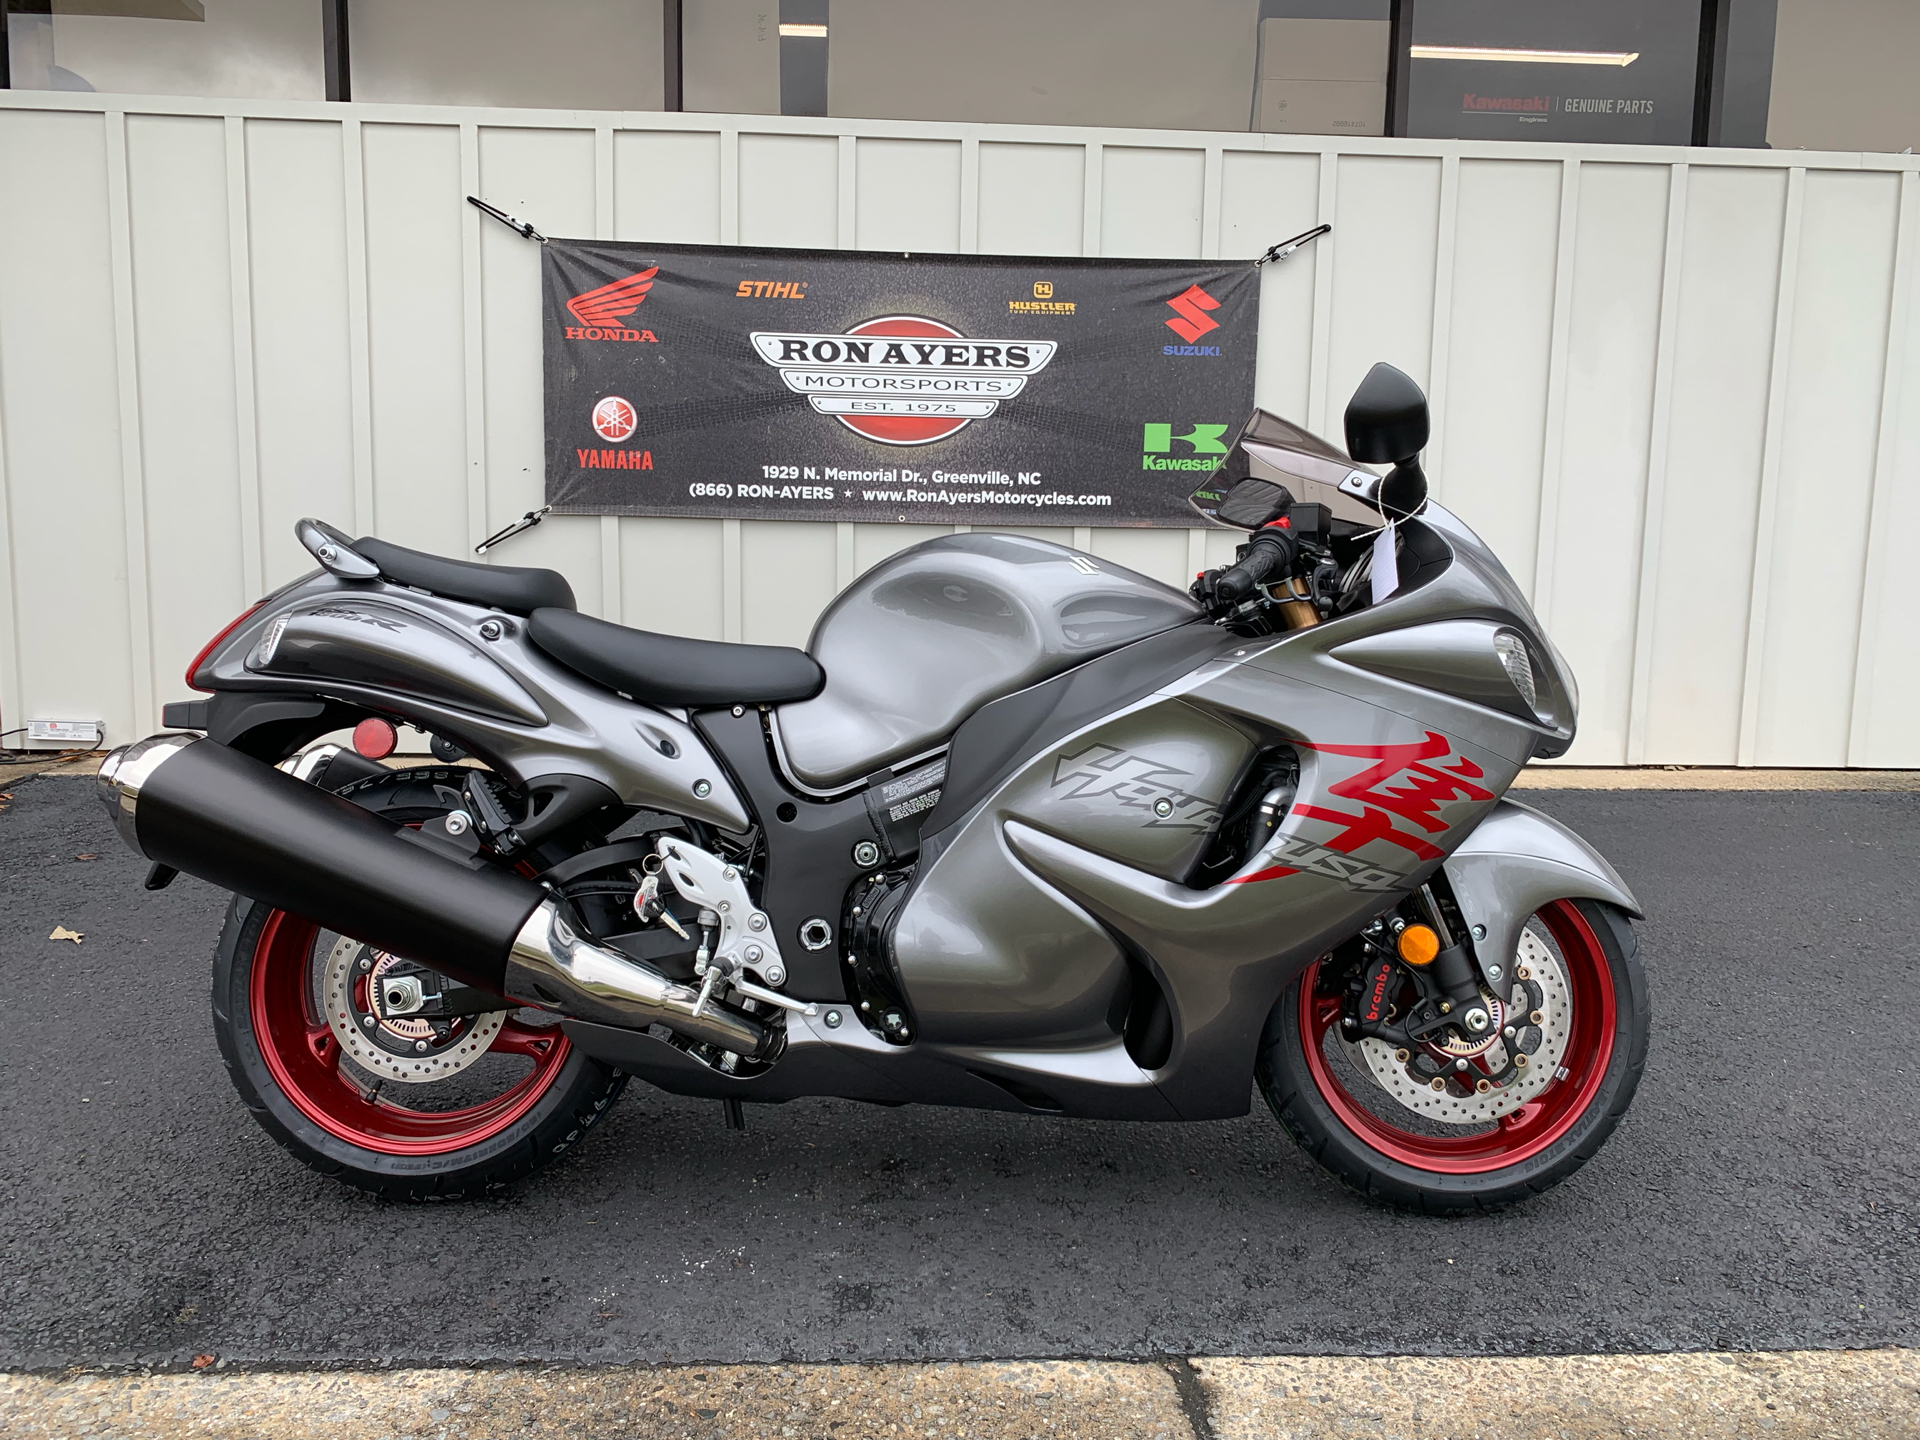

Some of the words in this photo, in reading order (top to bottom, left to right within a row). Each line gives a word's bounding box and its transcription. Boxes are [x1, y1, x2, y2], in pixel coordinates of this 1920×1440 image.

[1462, 93, 1551, 112] Kawasaki
[1564, 98, 1614, 114] GENUINE
[1616, 99, 1655, 115] PARTS
[1518, 116, 1549, 124] Engines
[1008, 301, 1076, 312] HUSTLER
[565, 326, 659, 343] HONDA
[777, 338, 875, 364] RON
[883, 341, 1030, 369] AYERS
[1162, 345, 1220, 357] SUZUKI
[804, 375, 1003, 392] MOTORSPORTS
[850, 401, 894, 411] EST.
[905, 403, 957, 413] 1975
[576, 449, 654, 470] YAMAHA
[1142, 454, 1227, 471] Kawasak
[762, 465, 800, 480] 1929
[803, 466, 821, 480] N.
[824, 466, 898, 482] Memorial
[901, 468, 928, 485] Dr.,
[931, 469, 1014, 487] Greenville,
[1017, 471, 1042, 486] NC
[688, 482, 733, 499] (866)
[737, 483, 834, 500] RON-AYERS
[861, 488, 1112, 507] www.RonAyersMotorcycles.com
[1365, 964, 1390, 1020] brembo
